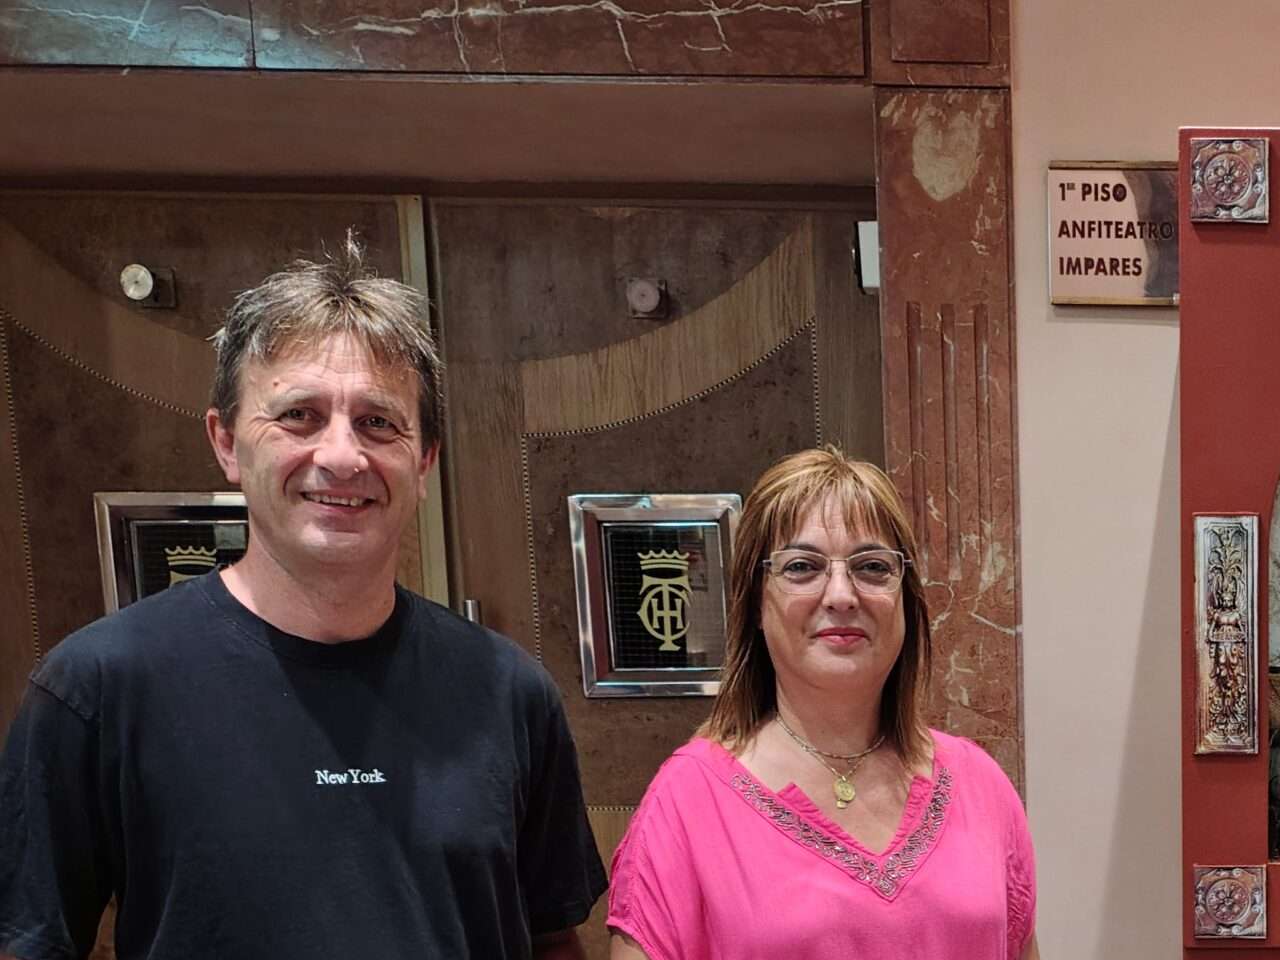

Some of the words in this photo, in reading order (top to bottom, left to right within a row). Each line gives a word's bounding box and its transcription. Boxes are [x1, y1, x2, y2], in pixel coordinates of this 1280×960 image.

[1082, 183, 1127, 202] PISO
[1058, 220, 1173, 239] ANFITEATRO
[1059, 257, 1142, 276] IMPARES
[314, 769, 348, 784] New
[347, 768, 387, 784] York
